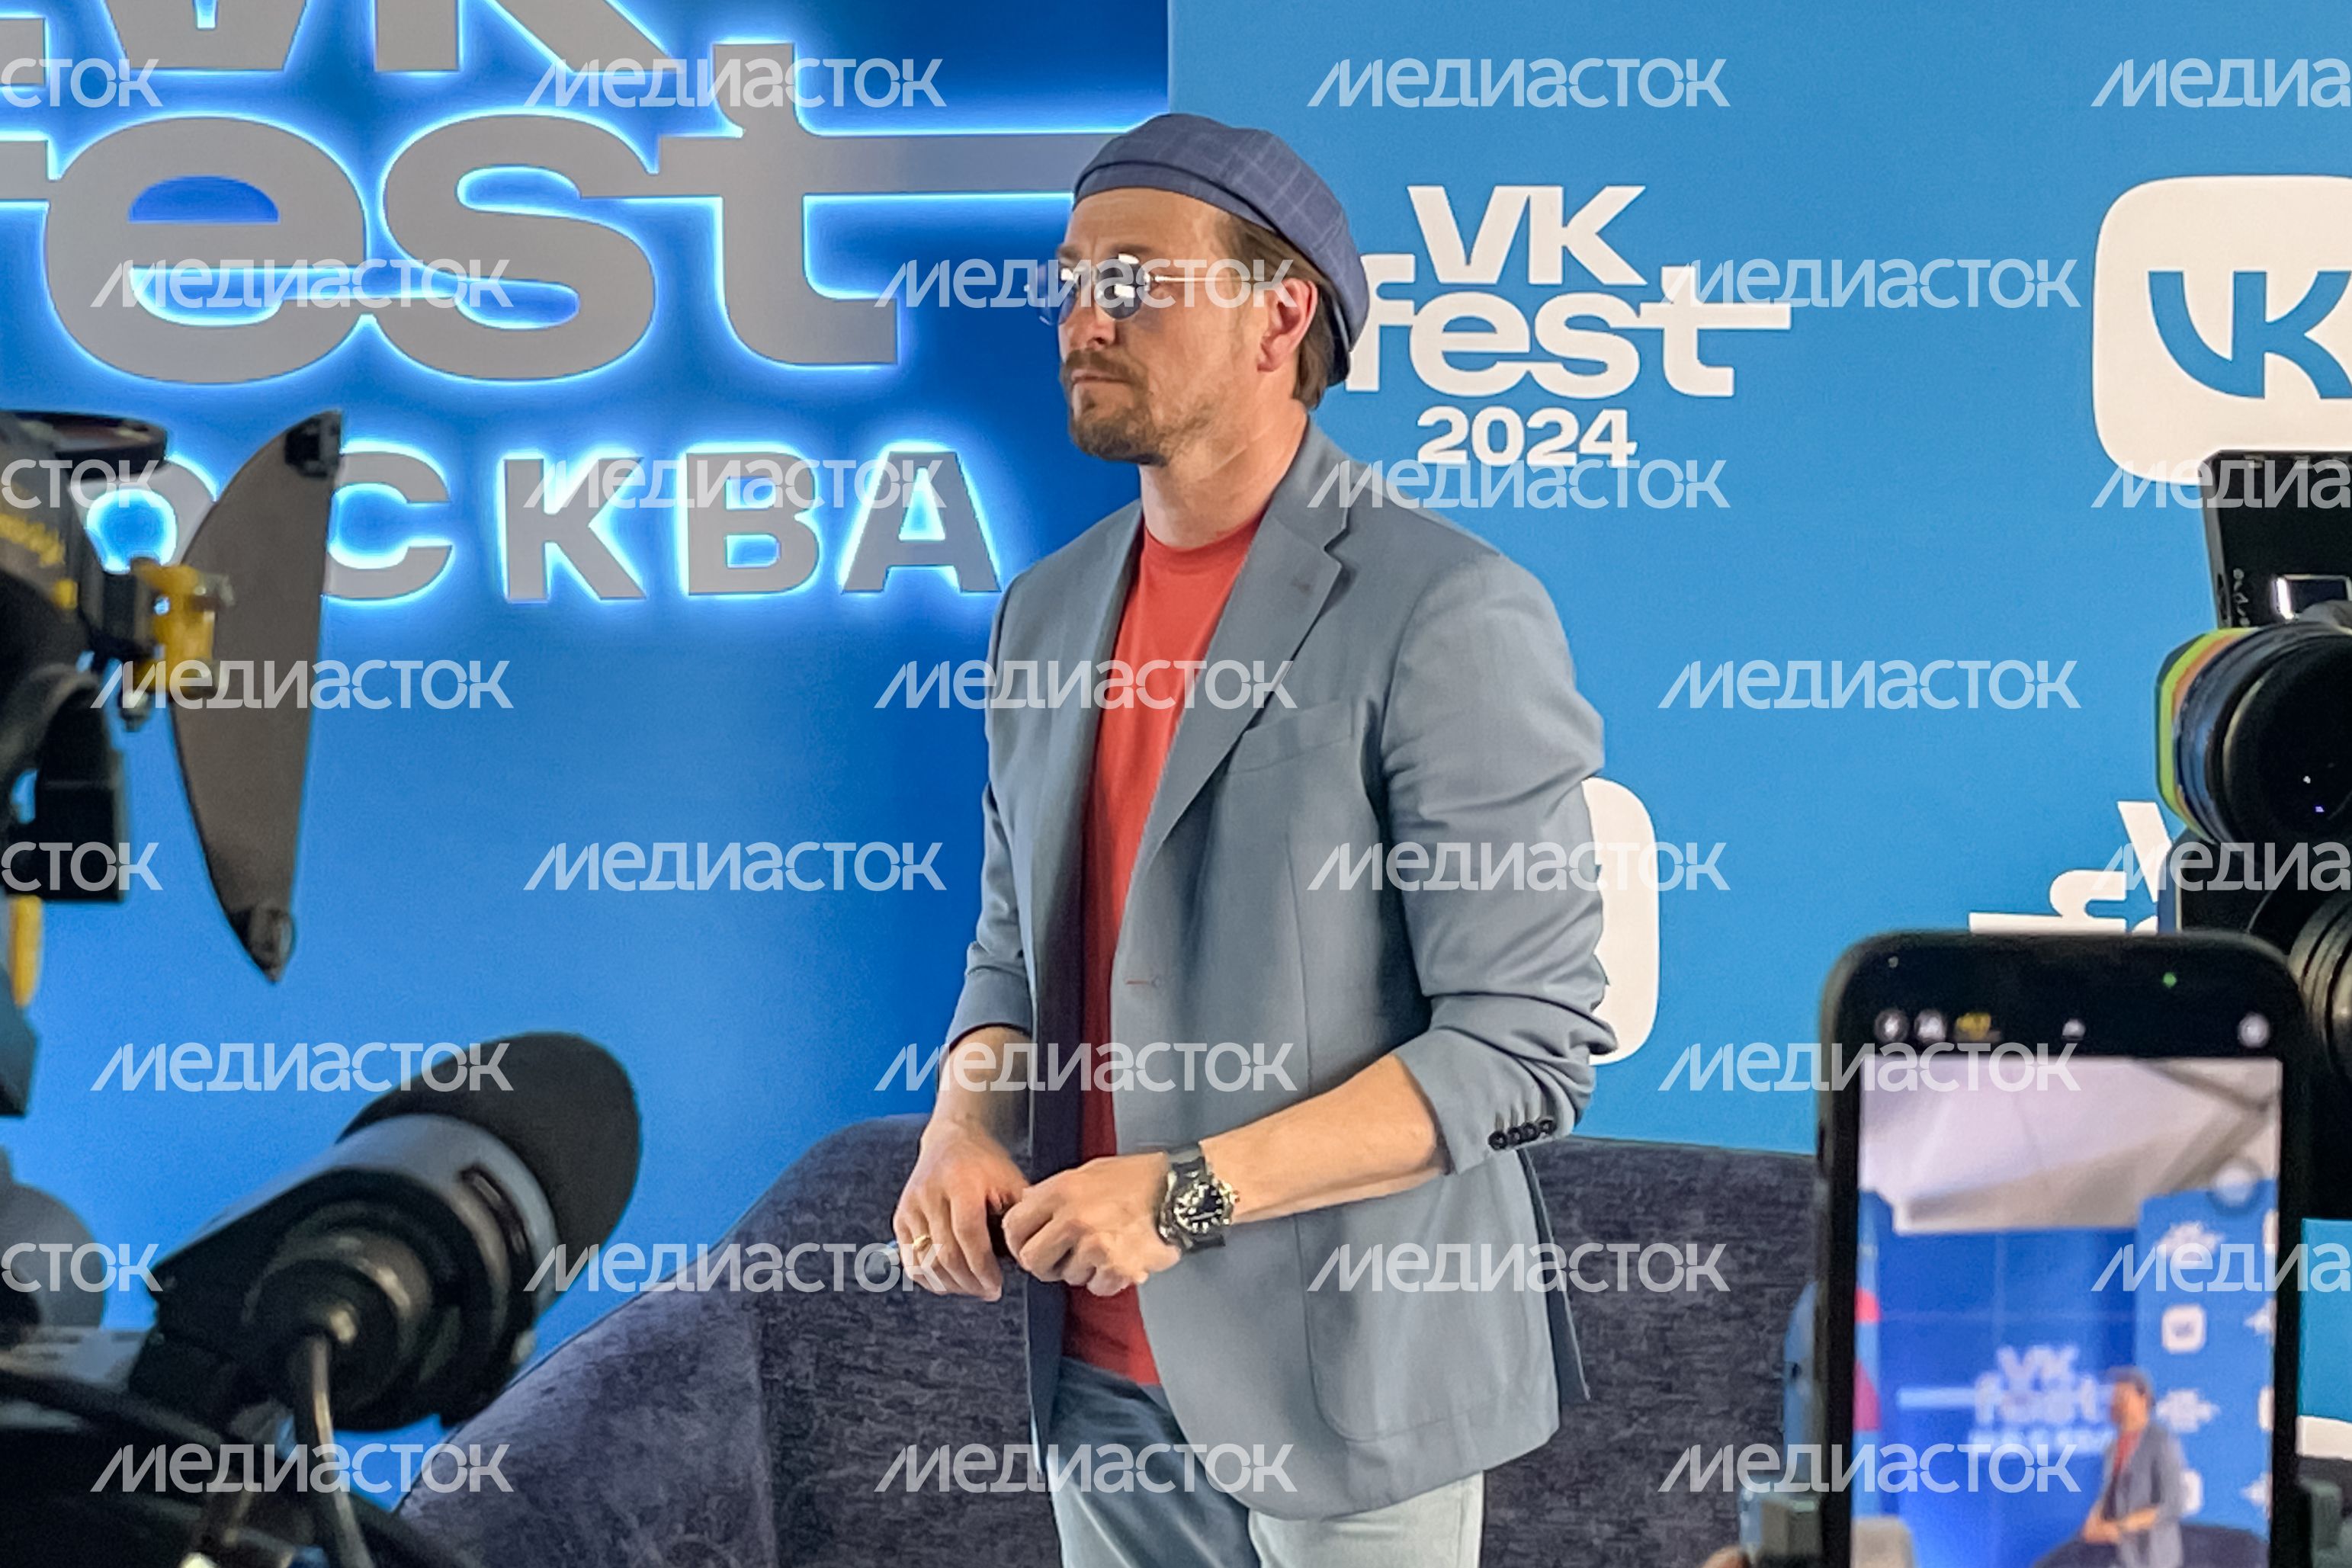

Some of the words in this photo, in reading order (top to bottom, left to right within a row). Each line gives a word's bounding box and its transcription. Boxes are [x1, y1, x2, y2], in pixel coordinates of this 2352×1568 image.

[0, 17, 1115, 385] est
[1407, 185, 1647, 285] VK
[1346, 254, 1792, 399] fest
[2148, 271, 2352, 399] VK
[1417, 406, 1638, 467] 2024
